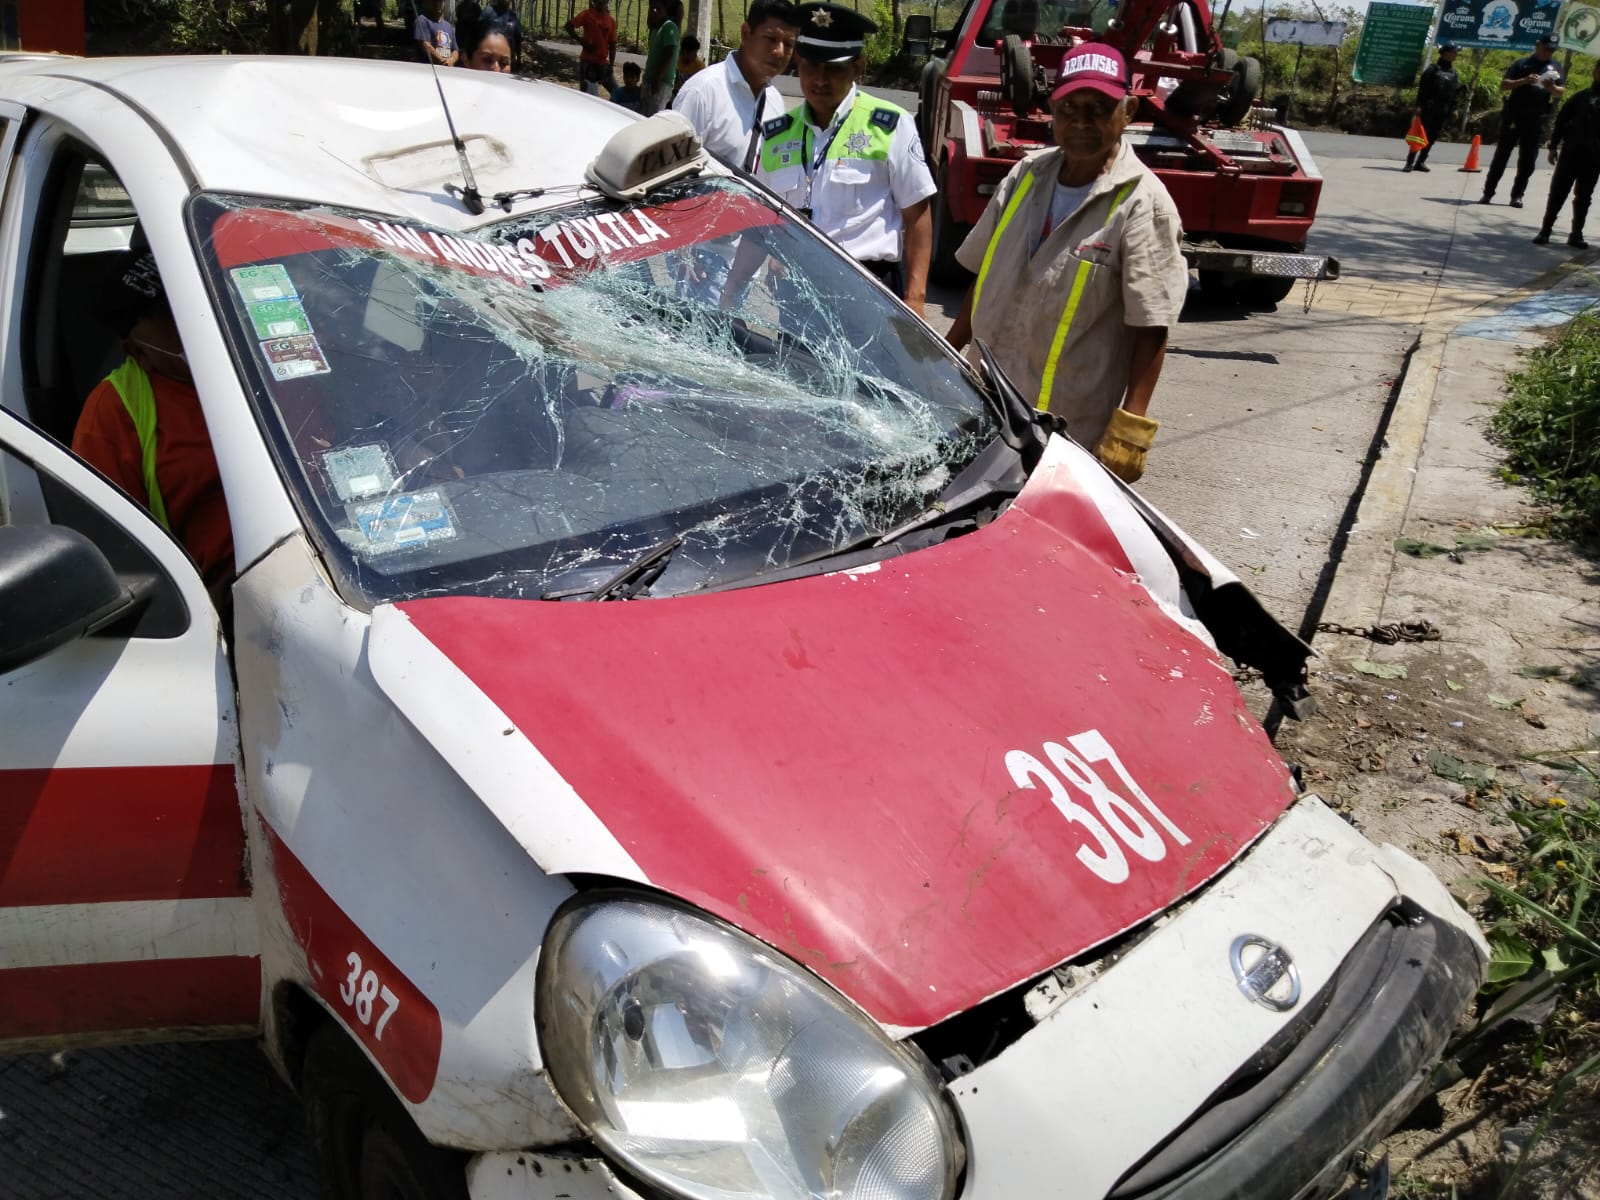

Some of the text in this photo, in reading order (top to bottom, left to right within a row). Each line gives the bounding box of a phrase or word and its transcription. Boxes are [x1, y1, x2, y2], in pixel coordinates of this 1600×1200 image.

[1443, 13, 1475, 23] Corona
[1519, 18, 1551, 28] Corona
[1062, 53, 1119, 77] ARKANSAS
[639, 136, 693, 175] TAXI
[357, 208, 671, 279] SAN ANDRES TUXTLA
[240, 270, 258, 279] EG
[270, 341, 290, 352] EG
[1004, 729, 1192, 884] 387
[339, 951, 400, 1041] 387
